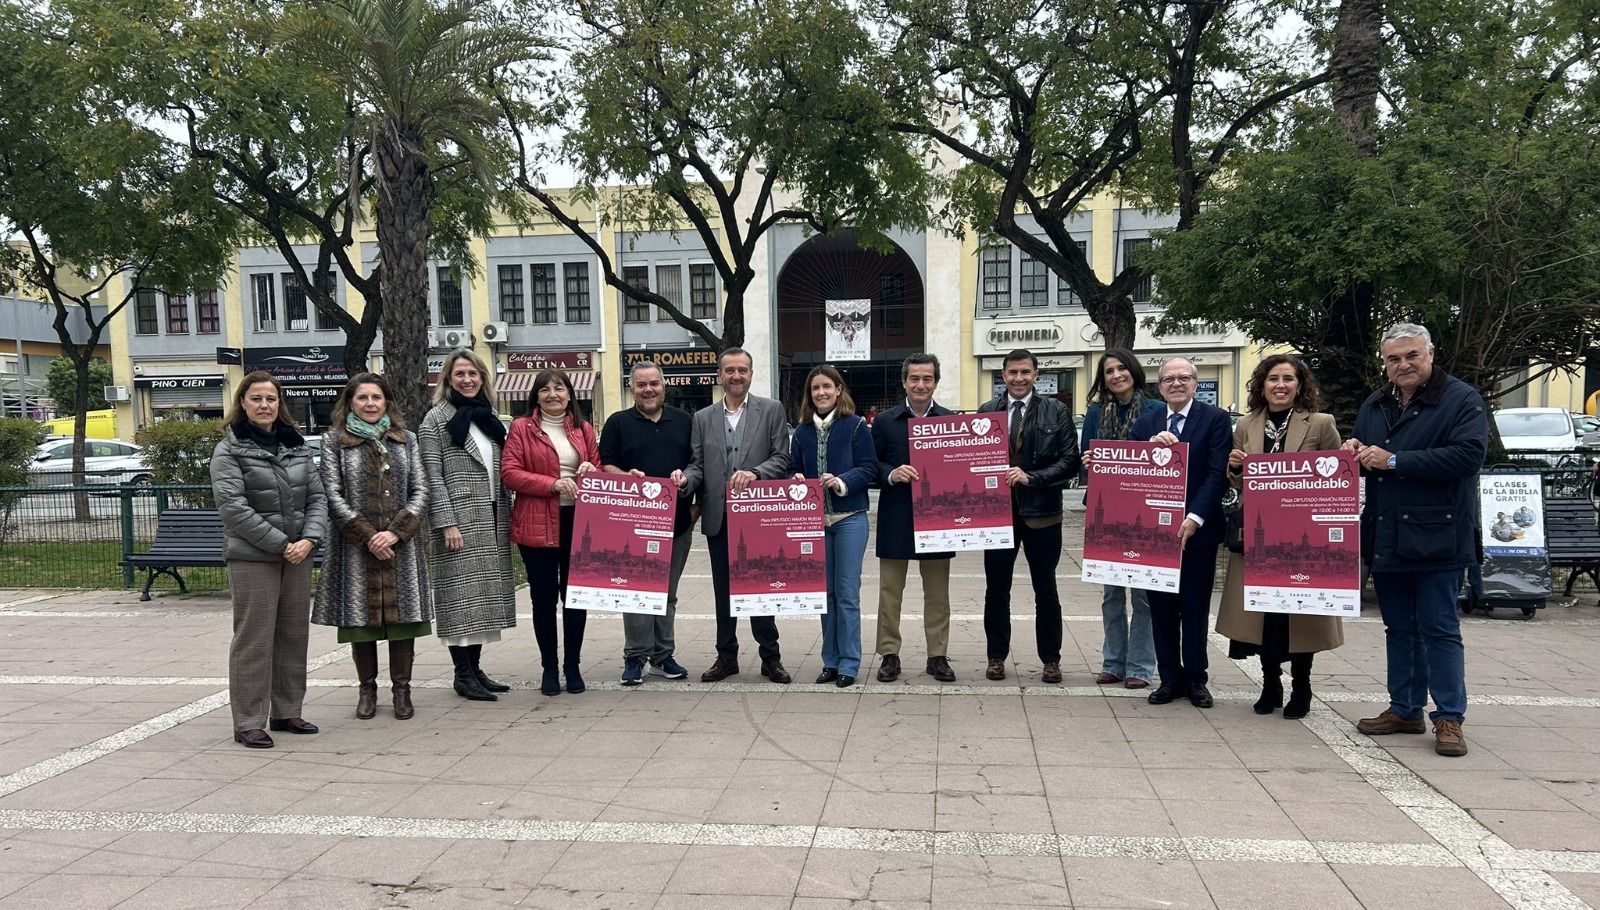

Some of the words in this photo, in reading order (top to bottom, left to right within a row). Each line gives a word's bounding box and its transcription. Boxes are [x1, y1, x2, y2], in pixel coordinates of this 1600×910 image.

[990, 328, 1060, 343] PERFUMERIA
[509, 353, 546, 364] Calzados
[654, 352, 718, 365] ROMEFER
[152, 380, 177, 388] PINO
[182, 379, 206, 387] CIEN
[664, 377, 691, 386] MEFER
[912, 422, 969, 436] SEVILLA
[914, 435, 1001, 450] Cardiosaludable
[1093, 447, 1149, 461] SEVILLA
[1093, 464, 1180, 478] Cardiosaludable
[1248, 460, 1312, 475] SEVILLA
[582, 478, 640, 494] SEVILLA
[1248, 478, 1350, 490] Cardiosaludable
[731, 487, 785, 499] SEVILLA
[581, 493, 668, 510] Cardiosaludable
[731, 502, 817, 512] Cardiosaludable
